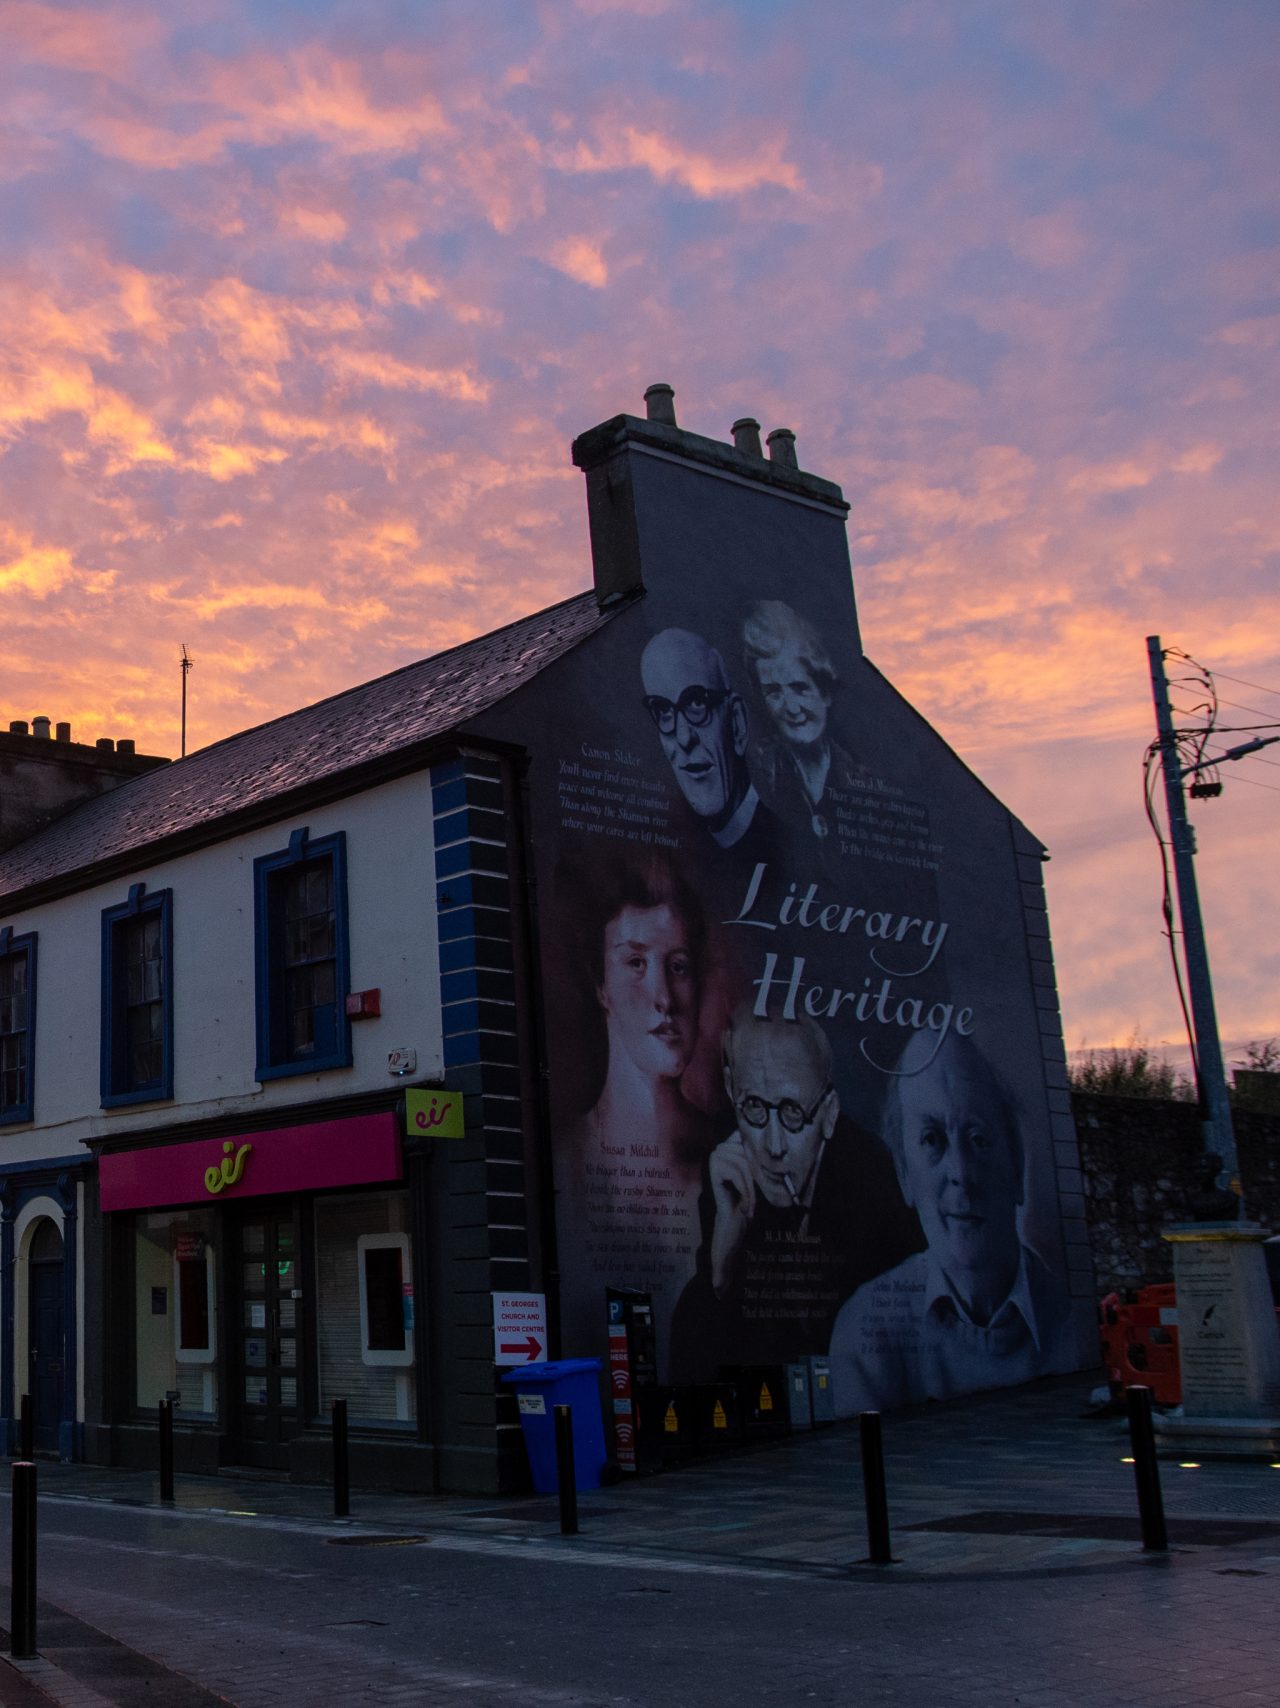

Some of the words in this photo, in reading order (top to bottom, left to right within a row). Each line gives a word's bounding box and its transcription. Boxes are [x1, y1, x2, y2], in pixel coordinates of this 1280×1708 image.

[721, 862, 949, 977] Literary
[752, 952, 976, 1077] Heritage
[415, 1098, 452, 1129] eir
[599, 1141, 626, 1157] Susan
[204, 1141, 253, 1194] eir
[501, 1300, 510, 1308] ST.
[511, 1300, 539, 1308] GEORGES
[610, 1302, 620, 1321] P
[501, 1313, 526, 1321] CHURCH
[527, 1313, 540, 1321] AND
[610, 1353, 629, 1361] HERE
